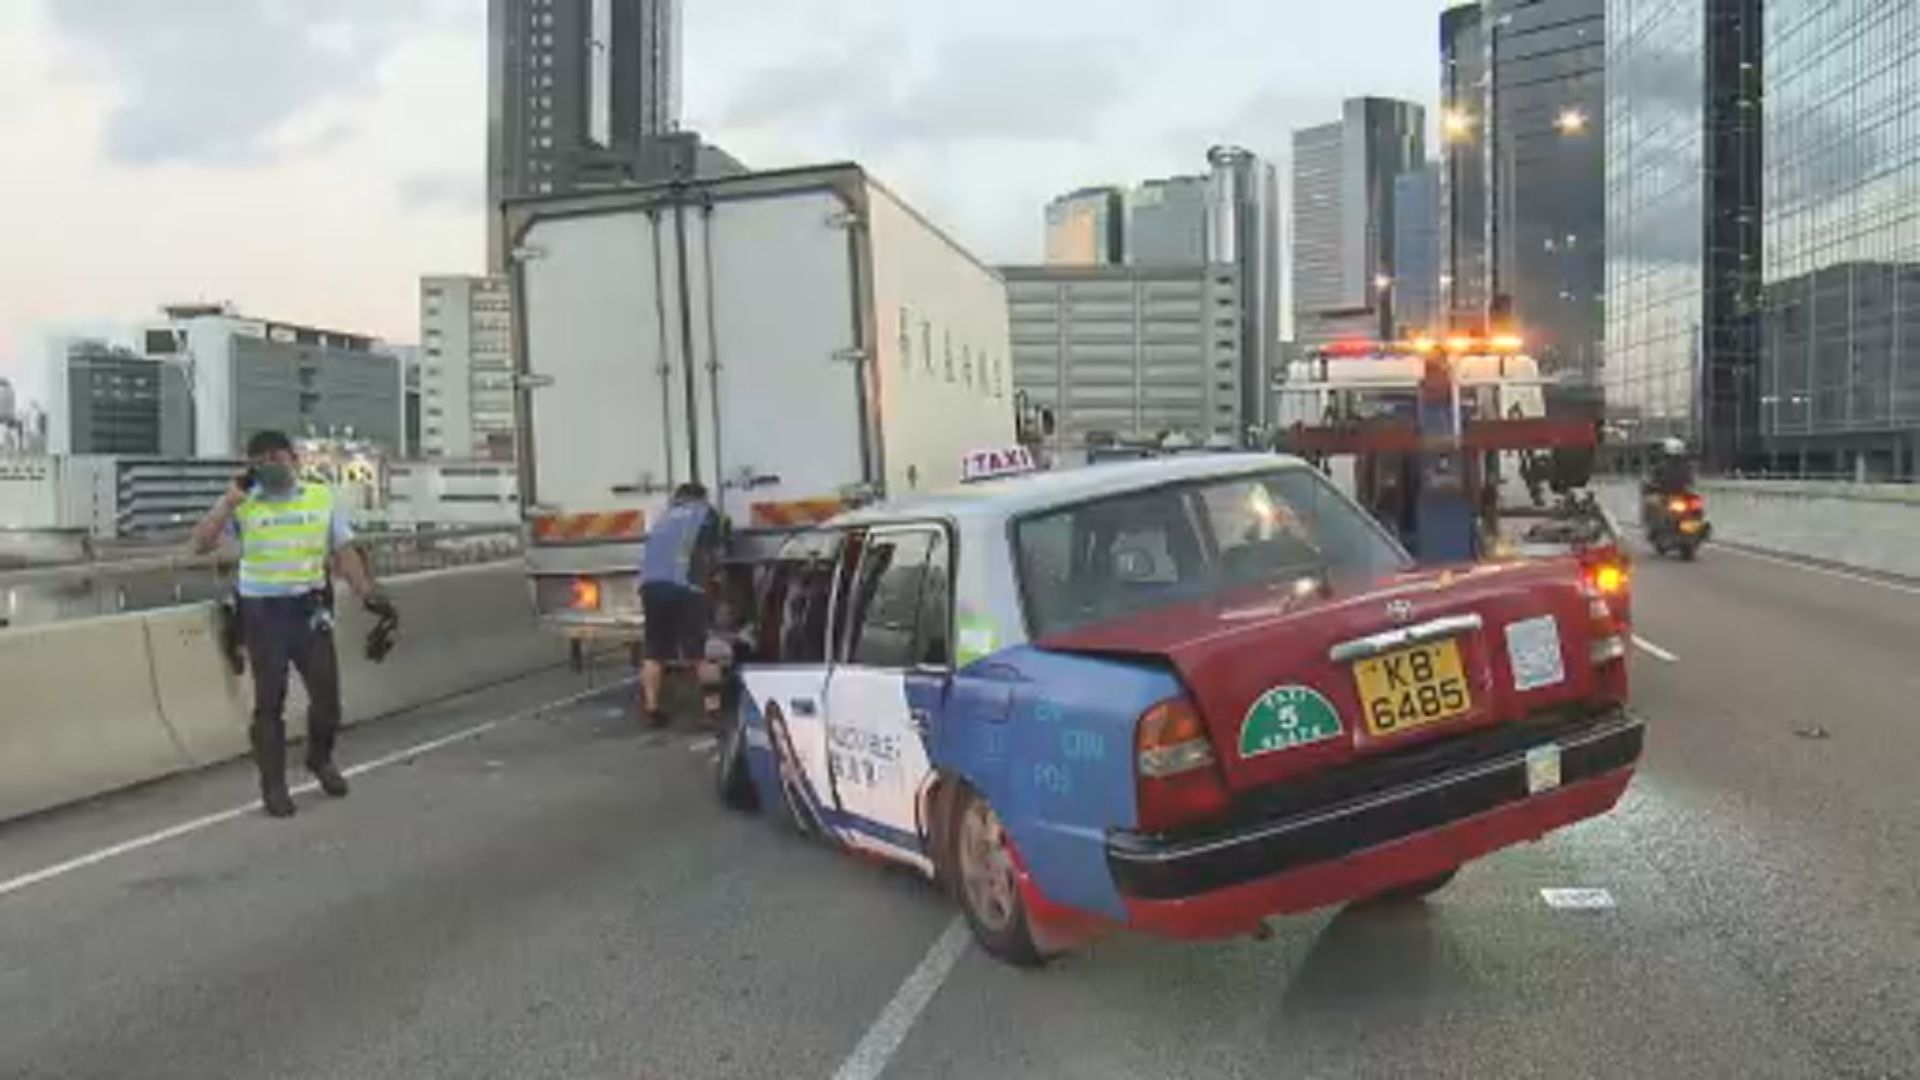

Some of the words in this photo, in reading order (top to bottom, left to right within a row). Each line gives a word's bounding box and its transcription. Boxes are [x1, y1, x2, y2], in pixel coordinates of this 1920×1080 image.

[973, 448, 1029, 473] TAXI
[1382, 649, 1434, 691] KB
[1278, 704, 1299, 730] 5
[1371, 677, 1465, 729] 6485
